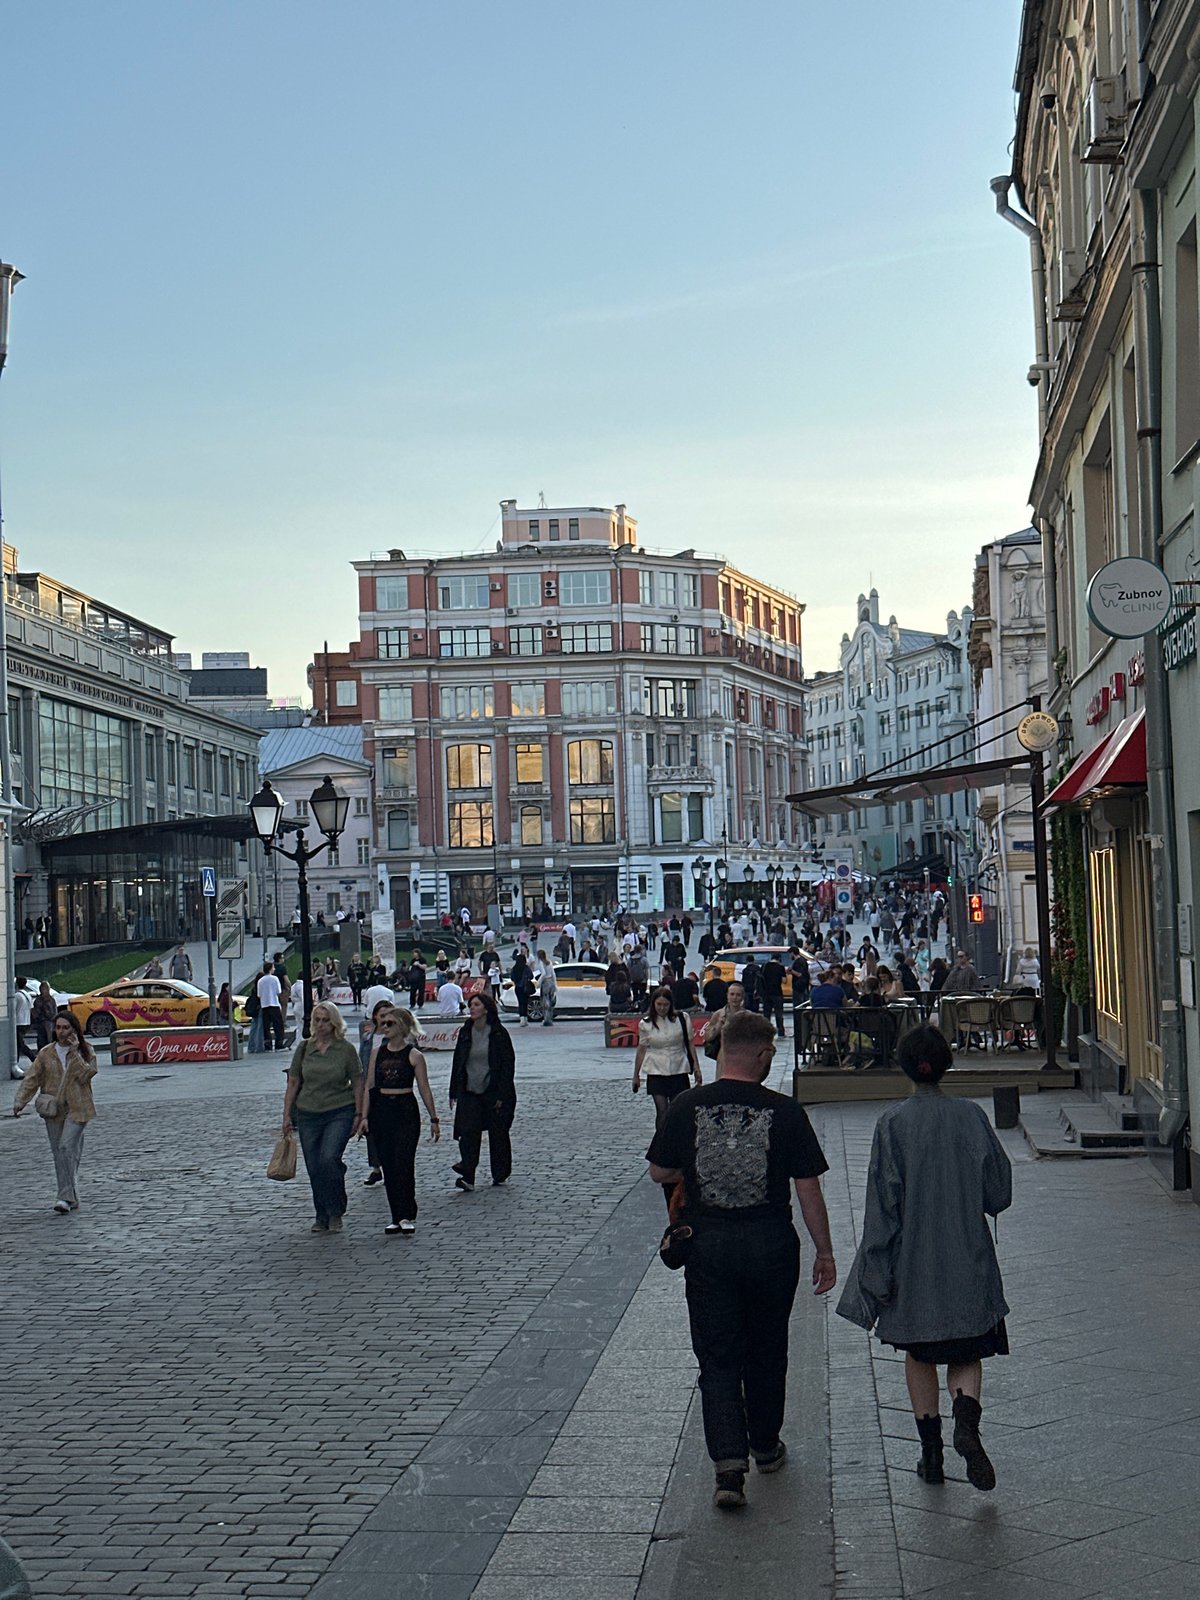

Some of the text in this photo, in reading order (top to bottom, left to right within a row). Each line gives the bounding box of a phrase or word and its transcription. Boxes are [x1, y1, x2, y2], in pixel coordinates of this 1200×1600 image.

[1117, 590, 1162, 600] Zubnov
[1122, 601, 1165, 613] CLINIC
[146, 1036, 228, 1062] Одна на всех
